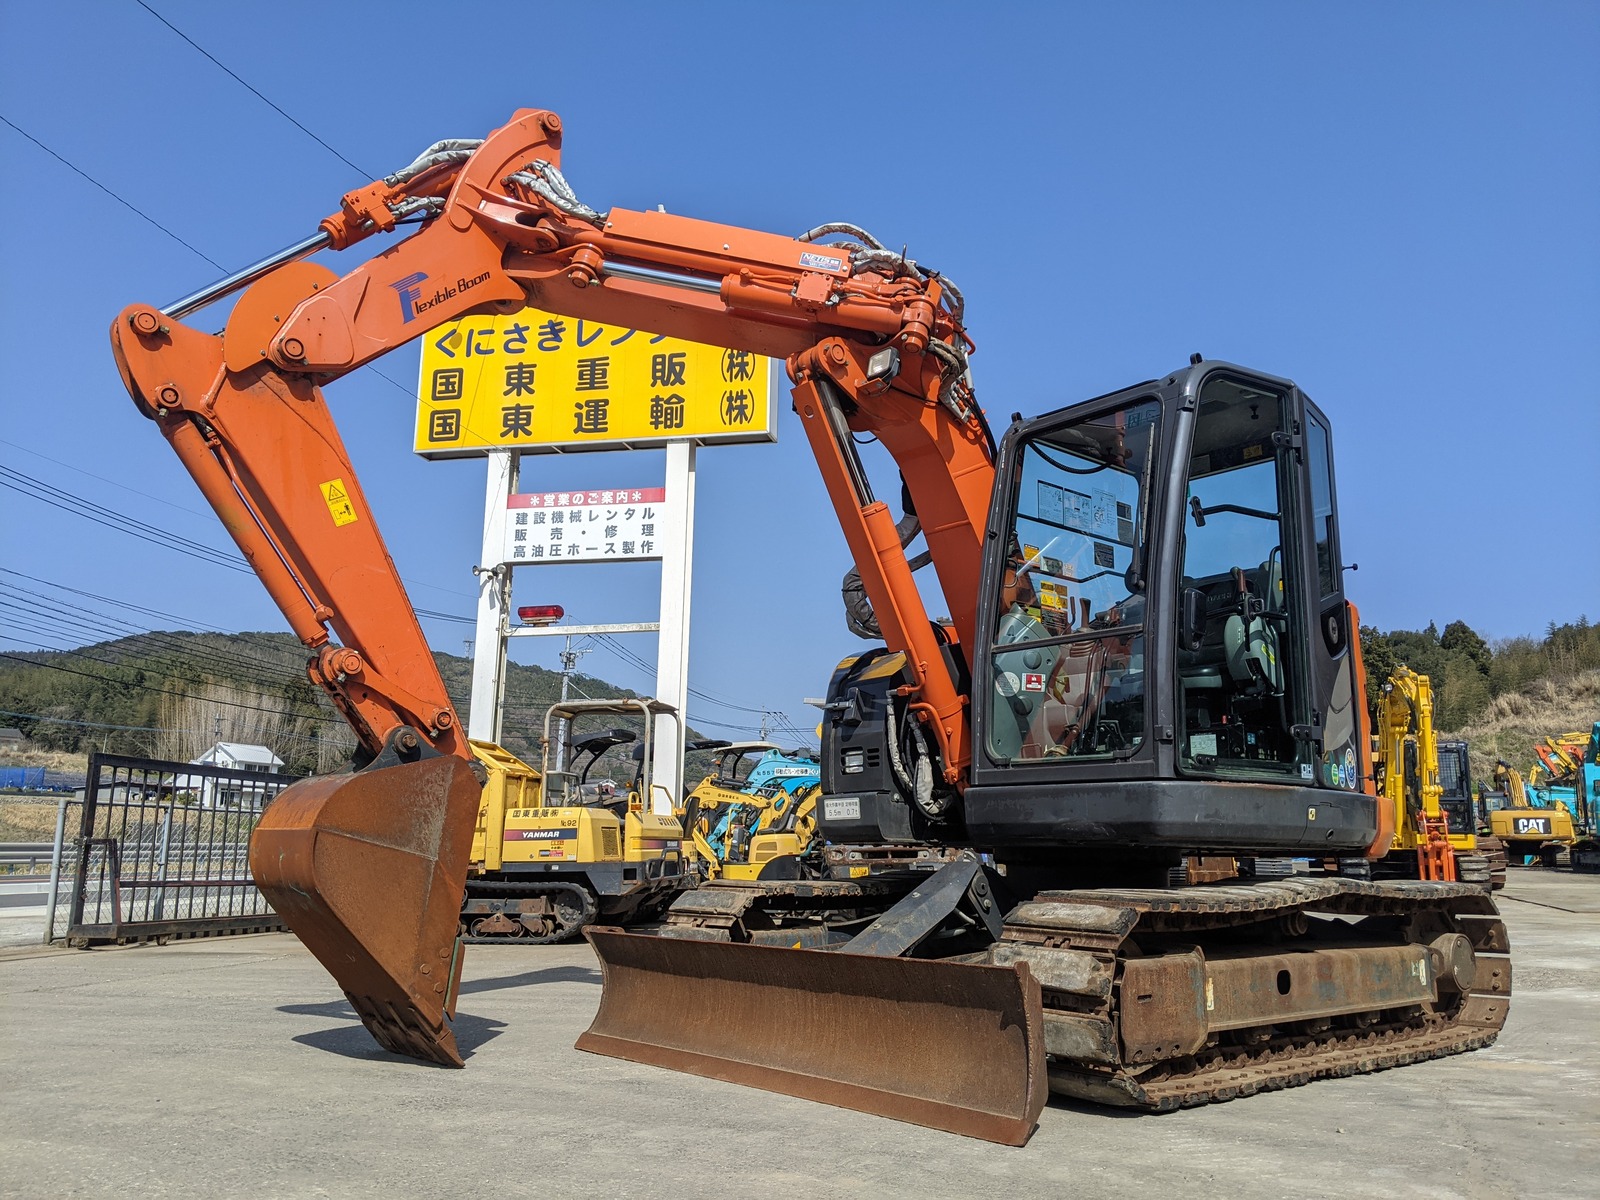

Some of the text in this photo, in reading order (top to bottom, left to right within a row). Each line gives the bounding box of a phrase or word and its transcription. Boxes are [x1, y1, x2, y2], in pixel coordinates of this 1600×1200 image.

[388, 271, 490, 324] Flexible Boom
[515, 507, 655, 526] 建設機械レンタル
[513, 540, 654, 558] 高油圧ホース製作
[522, 831, 560, 839] YANMAR
[1518, 819, 1545, 834] CAT
